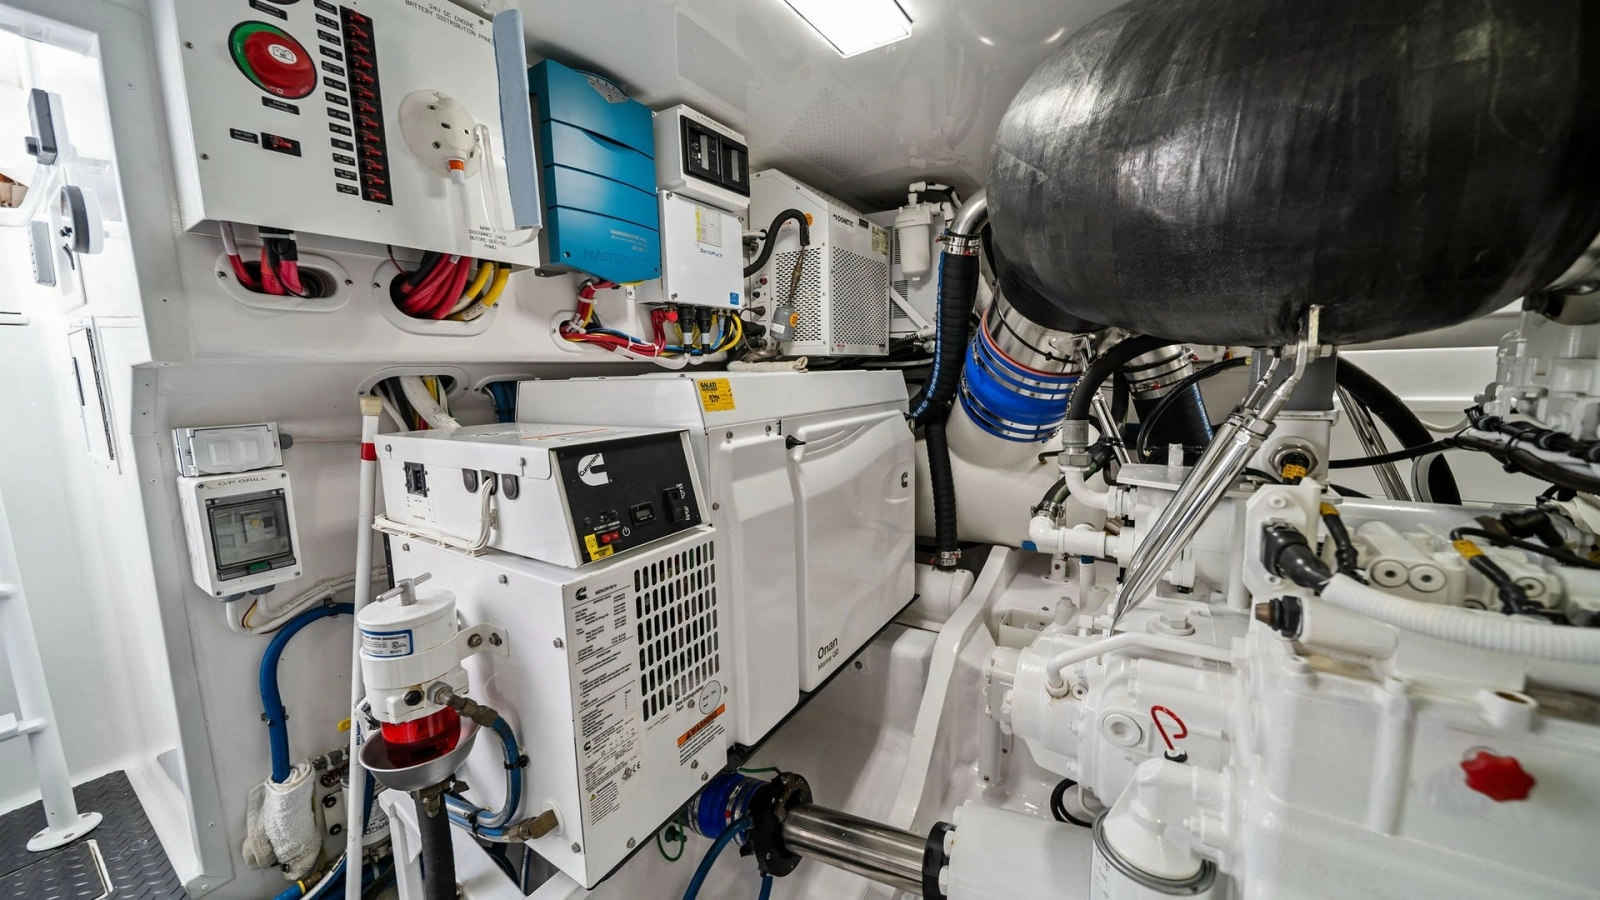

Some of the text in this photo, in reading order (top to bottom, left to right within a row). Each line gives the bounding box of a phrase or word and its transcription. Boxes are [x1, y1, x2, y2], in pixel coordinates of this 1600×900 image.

[405, 0, 434, 18] BATTERY
[436, 15, 476, 37] DISTRIBUTION
[454, 15, 475, 30] ENGINE
[577, 452, 601, 478] Cummins
[218, 476, 267, 487] C/P GRILL
[817, 637, 839, 660] Onan
